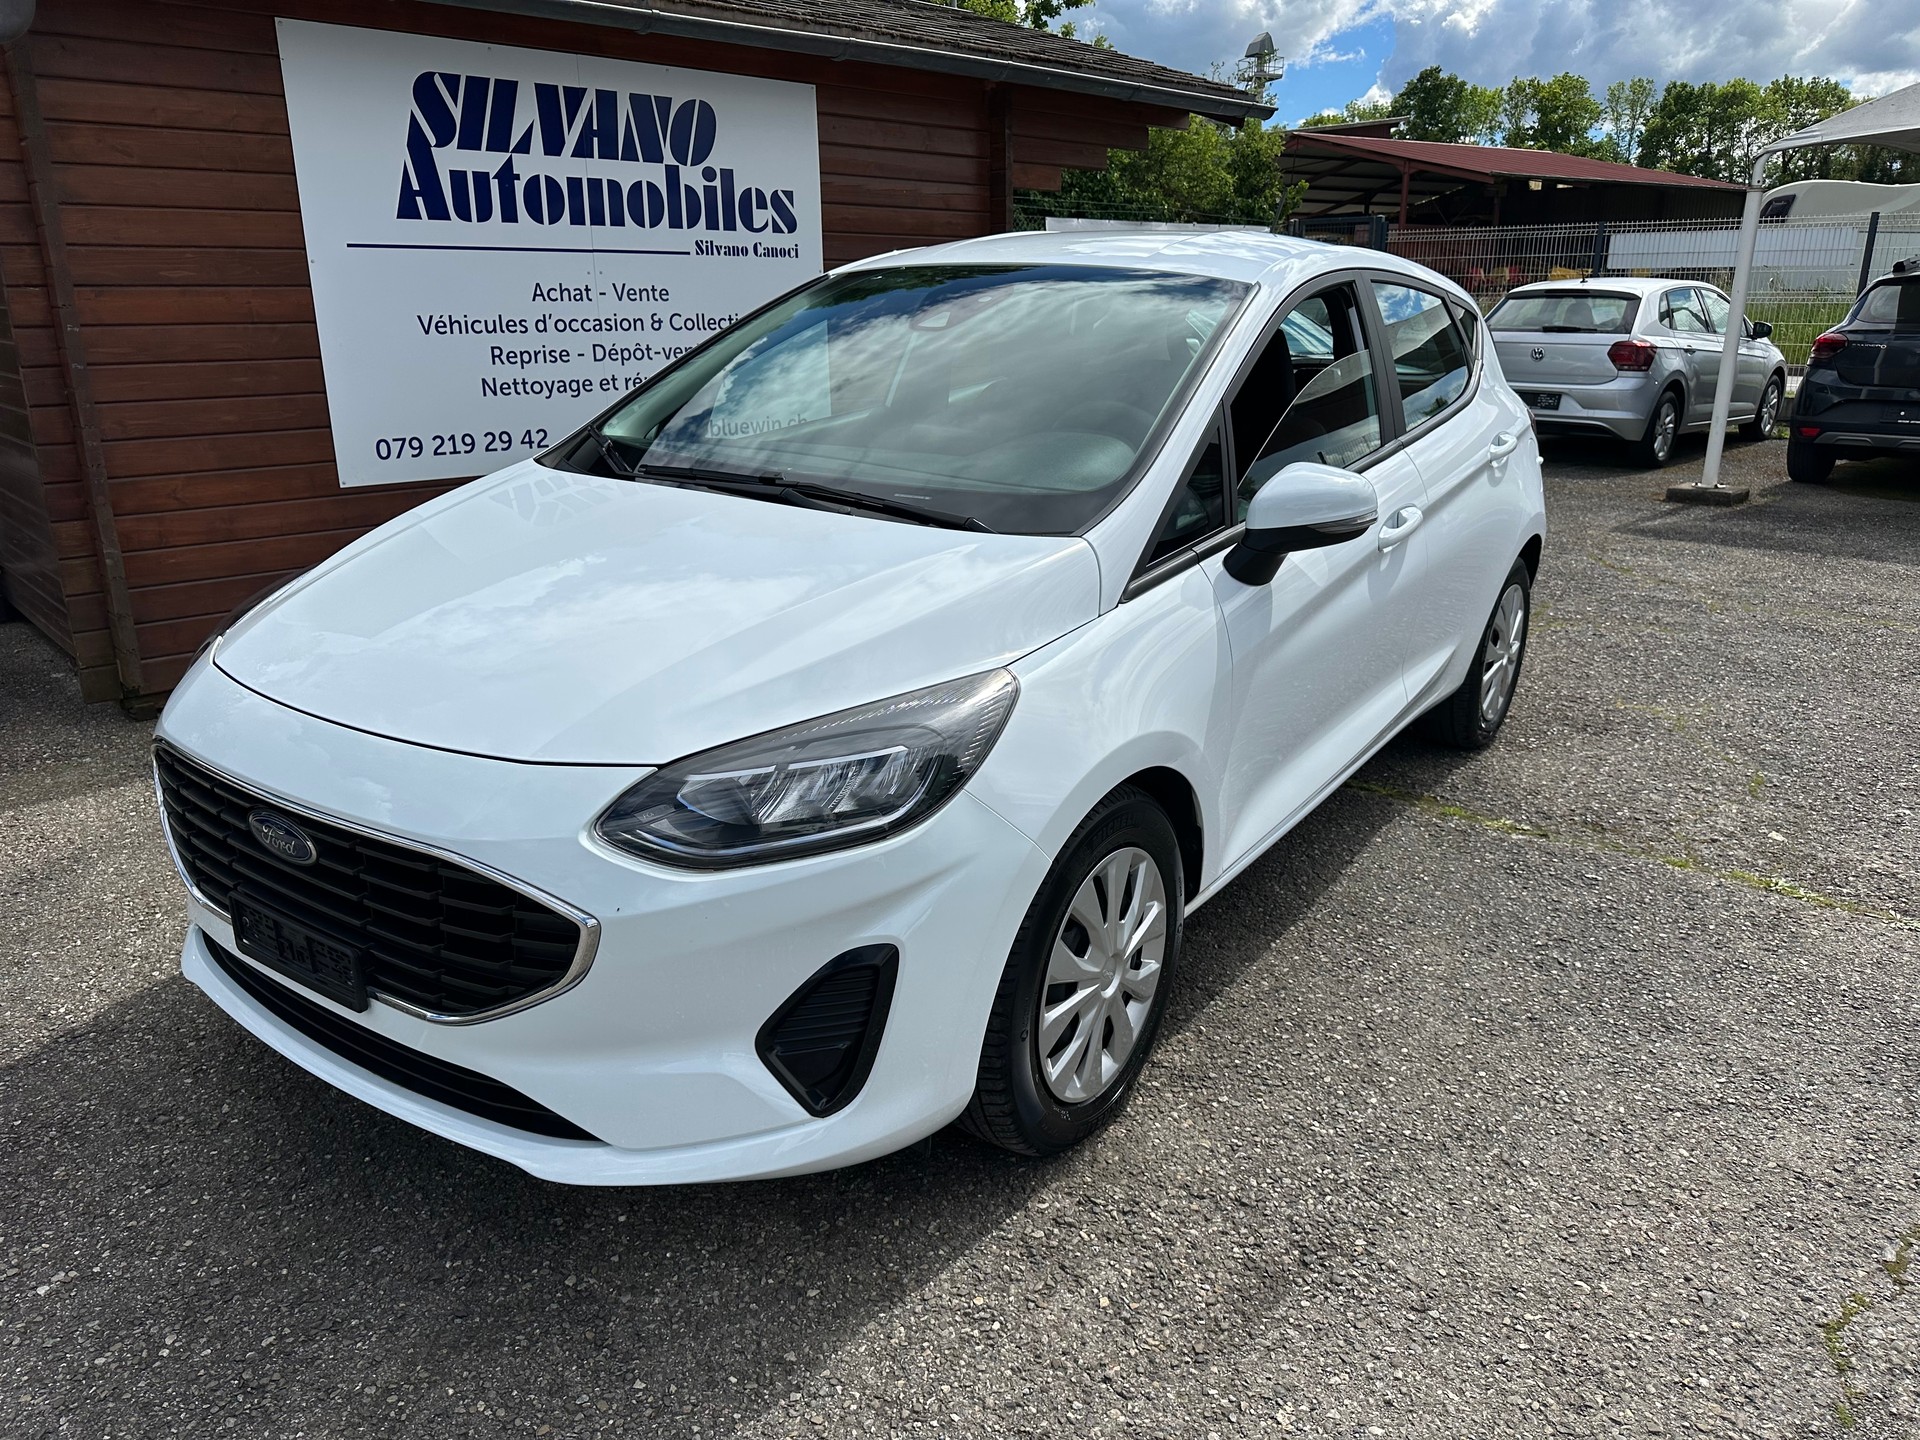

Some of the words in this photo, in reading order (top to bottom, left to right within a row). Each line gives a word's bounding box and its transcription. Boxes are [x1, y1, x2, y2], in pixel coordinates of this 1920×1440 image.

[406, 70, 717, 167] SILVANO
[396, 148, 798, 235] Automobiles
[694, 239, 749, 257] Silvano
[752, 241, 799, 259] Canoci
[531, 282, 592, 302] Achat
[612, 282, 670, 302] Vente
[416, 313, 529, 336] Véhicules
[650, 312, 663, 331] &
[490, 345, 571, 369] Reprise
[481, 374, 593, 399] Nettoyage
[599, 374, 619, 392] et
[375, 437, 424, 461] 079
[432, 433, 476, 456] 219
[484, 431, 513, 451] 29
[520, 428, 549, 449] 42
[262, 823, 297, 856] Ford
